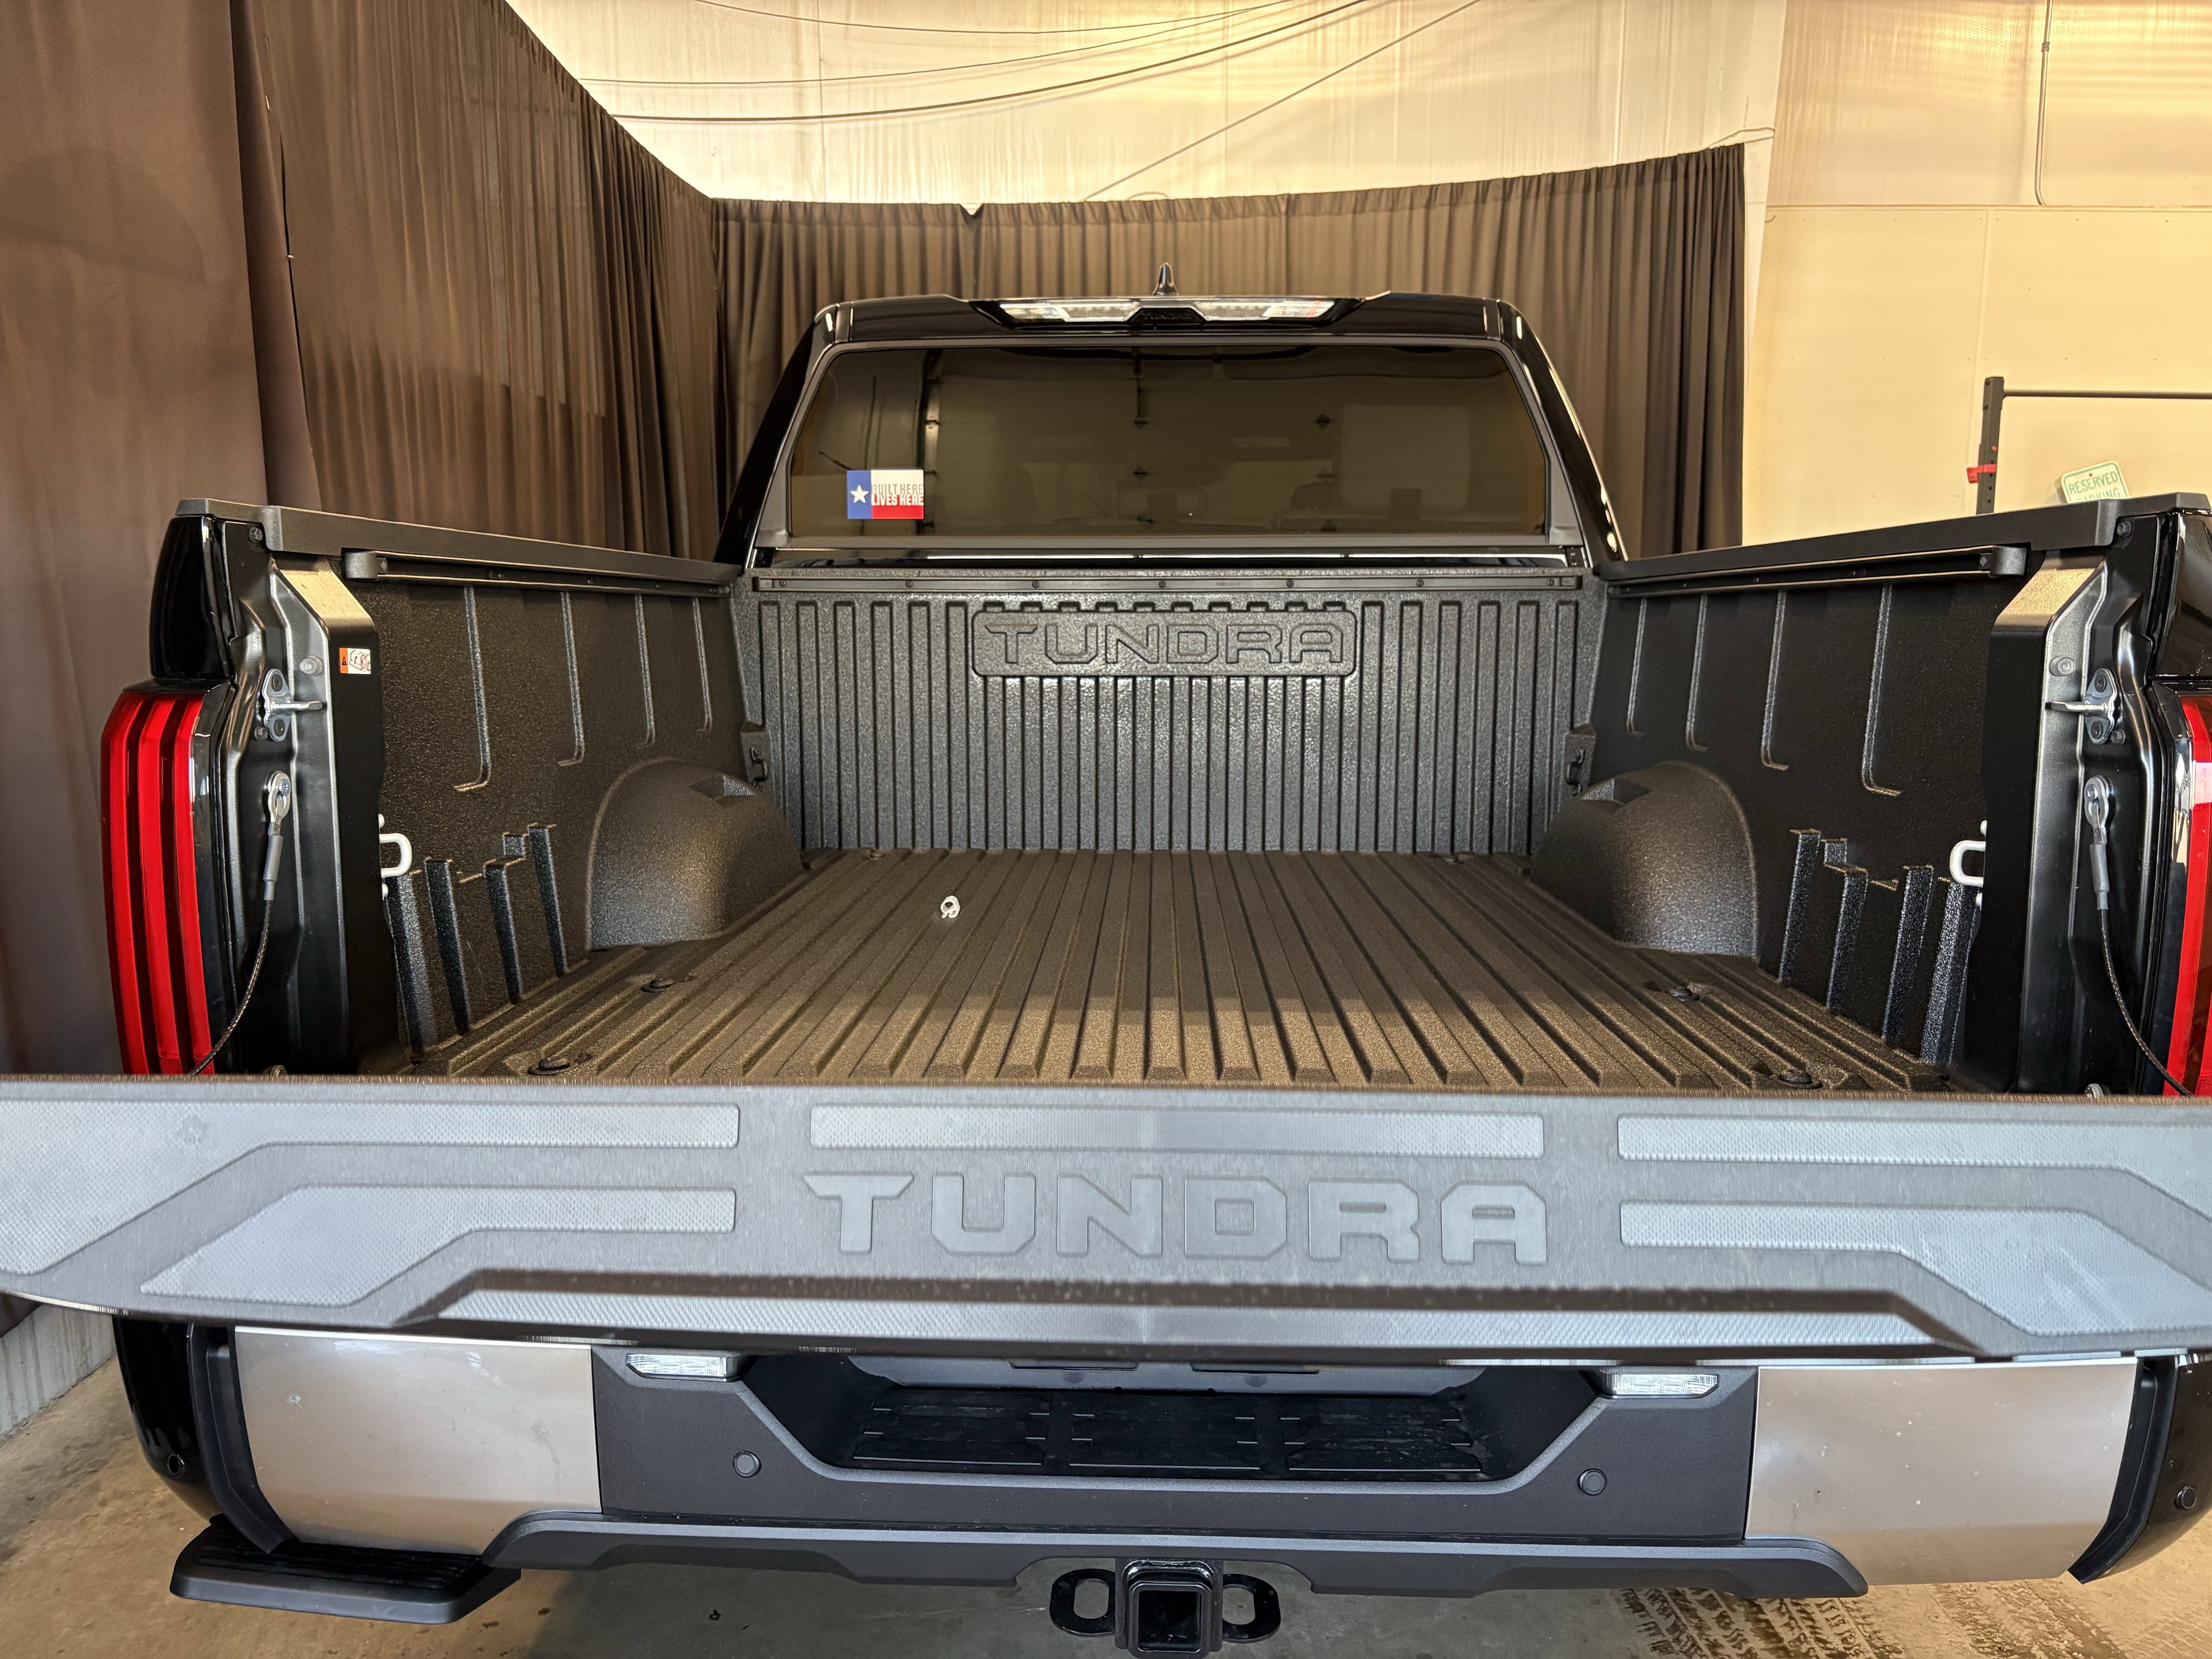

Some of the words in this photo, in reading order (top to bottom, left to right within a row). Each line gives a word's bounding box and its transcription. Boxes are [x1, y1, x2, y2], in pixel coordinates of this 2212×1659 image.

[872, 484, 898, 495] BUILT
[900, 484, 924, 495] HERE
[2068, 471, 2118, 495] RESERVED
[871, 494, 898, 506] LIVES
[899, 494, 924, 506] HERE
[2076, 487, 2120, 500] KING
[984, 624, 1343, 664] TUNDRA
[802, 1171, 1549, 1265] TUNDRA
